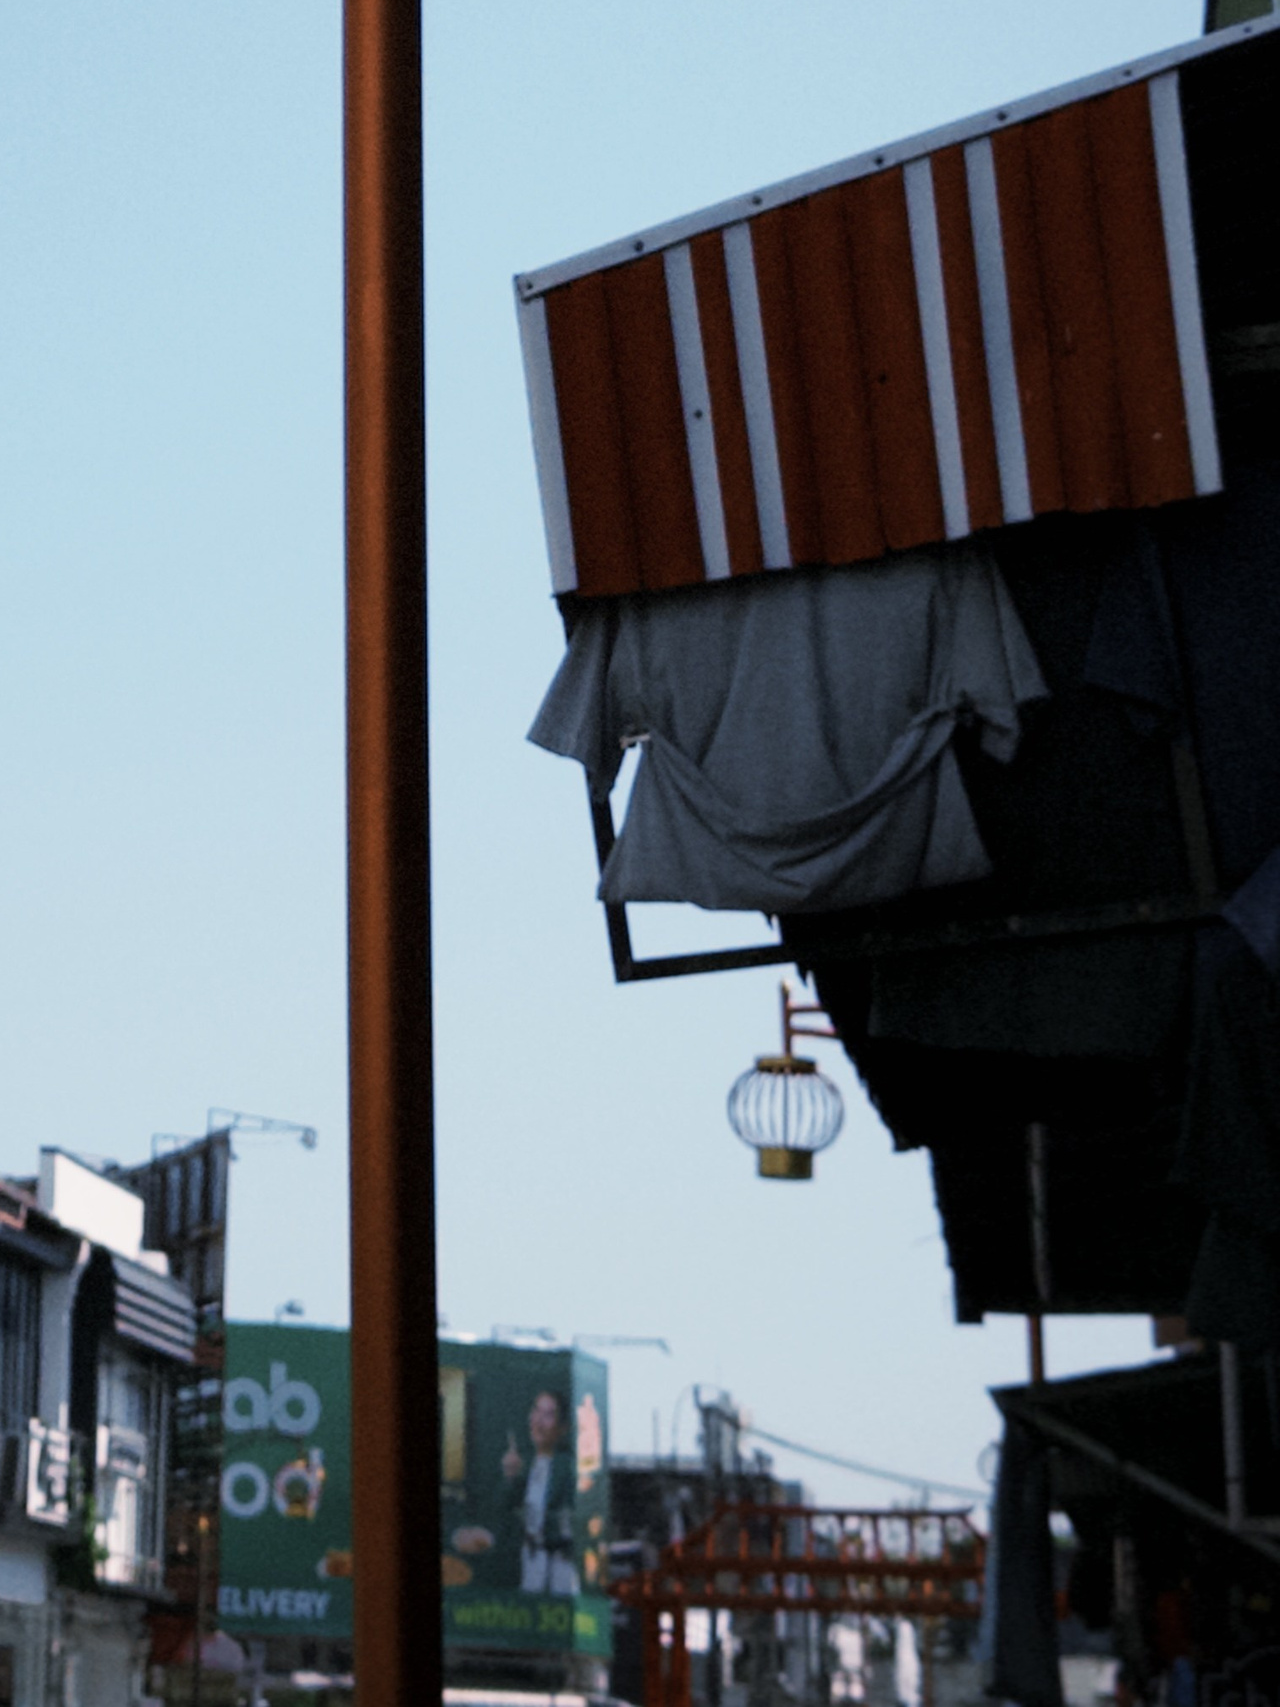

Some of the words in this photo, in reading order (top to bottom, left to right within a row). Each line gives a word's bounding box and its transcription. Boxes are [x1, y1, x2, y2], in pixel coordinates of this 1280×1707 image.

[221, 1361, 321, 1438] ab
[220, 1447, 324, 1521] od
[217, 1585, 331, 1619] ELIVERY
